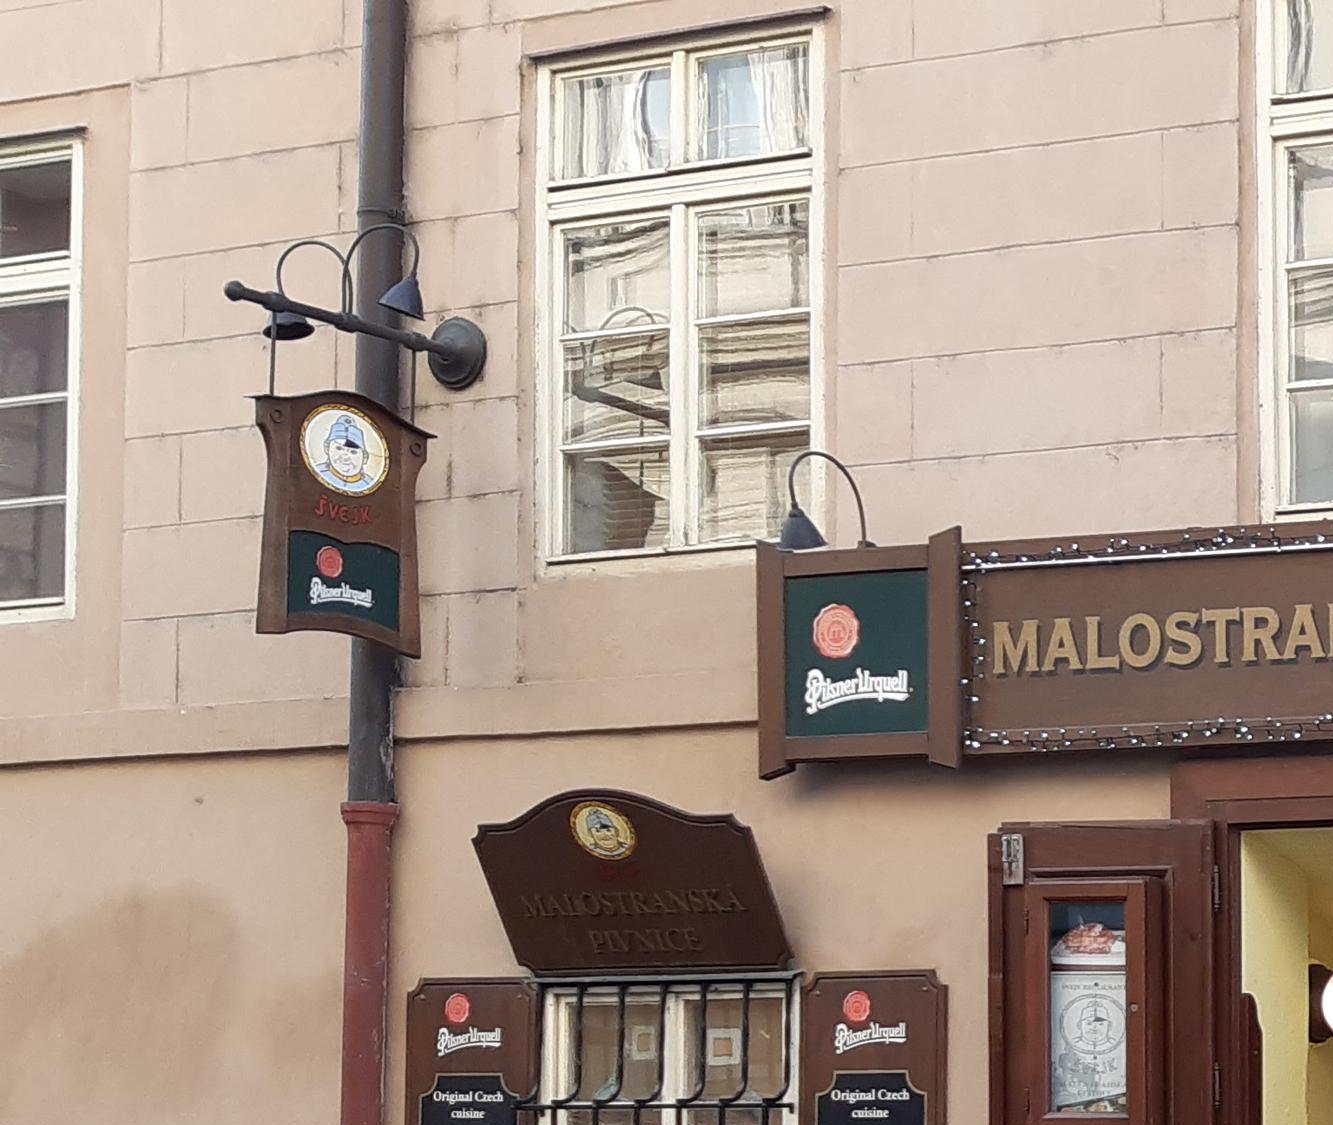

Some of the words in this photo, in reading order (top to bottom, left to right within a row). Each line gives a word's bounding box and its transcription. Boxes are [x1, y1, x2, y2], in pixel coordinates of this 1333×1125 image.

[315, 495, 371, 525] ŠVEJK
[310, 577, 342, 605] Pilsner
[341, 582, 372, 607] Urquell
[804, 668, 860, 714] Pilsner
[855, 667, 908, 702] Urquell
[521, 883, 749, 918] MALOSTRANSKÁ
[589, 927, 705, 953] PIVNICE
[437, 1027, 471, 1056] Pilsner
[468, 1026, 502, 1047] Urquell
[834, 1022, 873, 1054] Pilsner
[870, 1021, 907, 1044] Urquell
[433, 1090, 473, 1105] Original
[474, 1090, 504, 1102] Czech
[830, 1089, 875, 1104] Original
[877, 1089, 910, 1101] Czech
[451, 1107, 486, 1118] cuisine
[851, 1106, 889, 1118] cuisine
